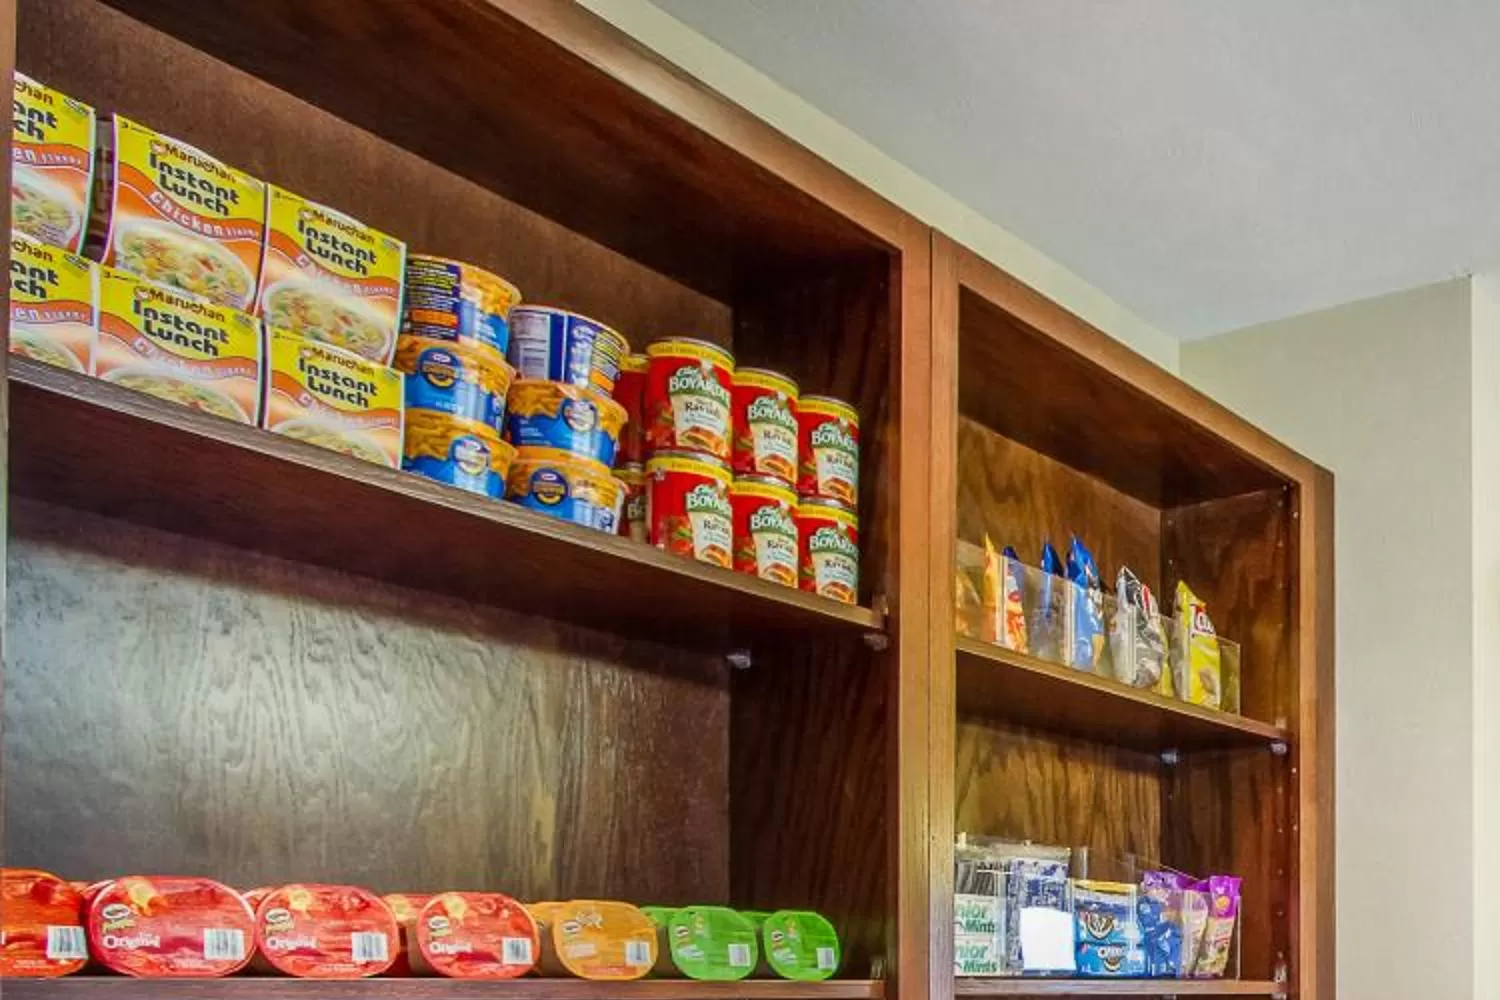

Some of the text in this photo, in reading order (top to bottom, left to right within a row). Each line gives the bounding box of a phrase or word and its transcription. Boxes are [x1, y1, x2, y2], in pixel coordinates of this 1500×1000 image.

[149, 153, 240, 204] Instant
[159, 174, 229, 216] Lunch
[298, 219, 377, 265] Instant
[306, 238, 368, 276] Lunch
[133, 299, 229, 344] Instant
[144, 320, 219, 357] Lunch
[298, 357, 378, 396] Instant
[307, 375, 369, 408] Lunch
